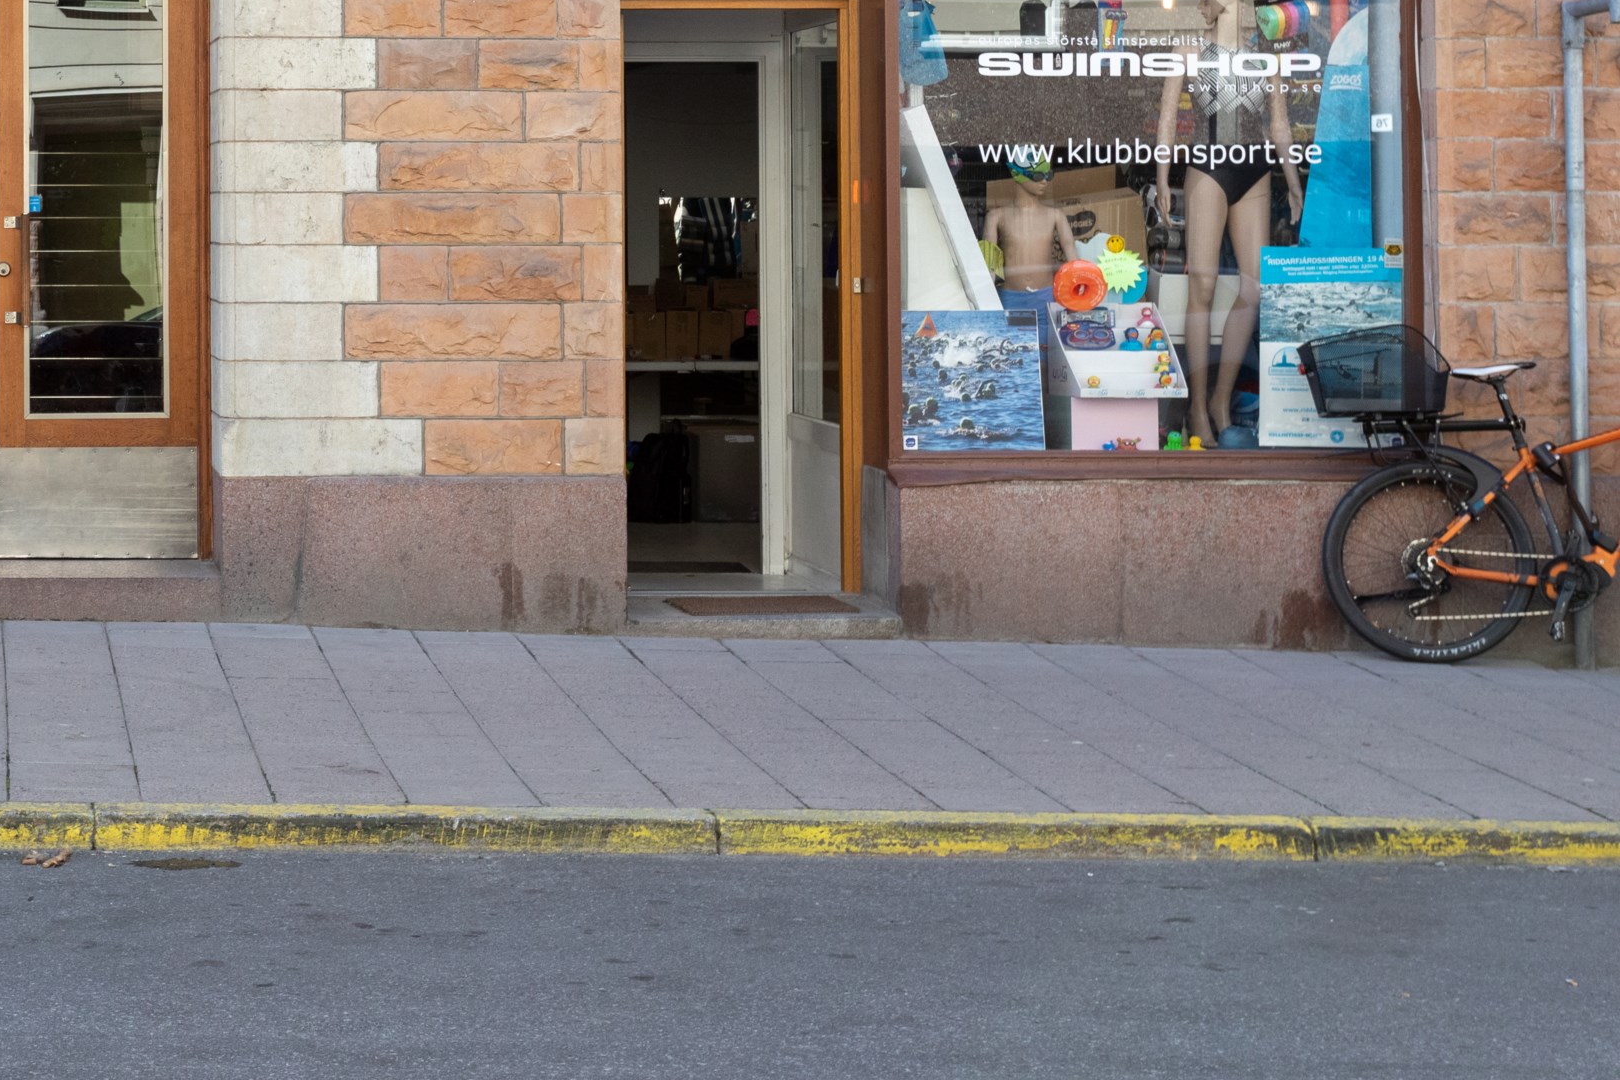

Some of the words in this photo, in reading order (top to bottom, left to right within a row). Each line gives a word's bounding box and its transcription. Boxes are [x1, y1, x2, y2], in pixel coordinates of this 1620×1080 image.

[978, 37, 1040, 49] europas
[1046, 34, 1099, 47] största
[1104, 34, 1204, 50] simspecialist
[978, 52, 1322, 78] SWIMSHOP
[1187, 79, 1322, 95] swimshop.se
[1330, 73, 1363, 86] ZOGGS
[978, 137, 1323, 169] www.klubbensport.se
